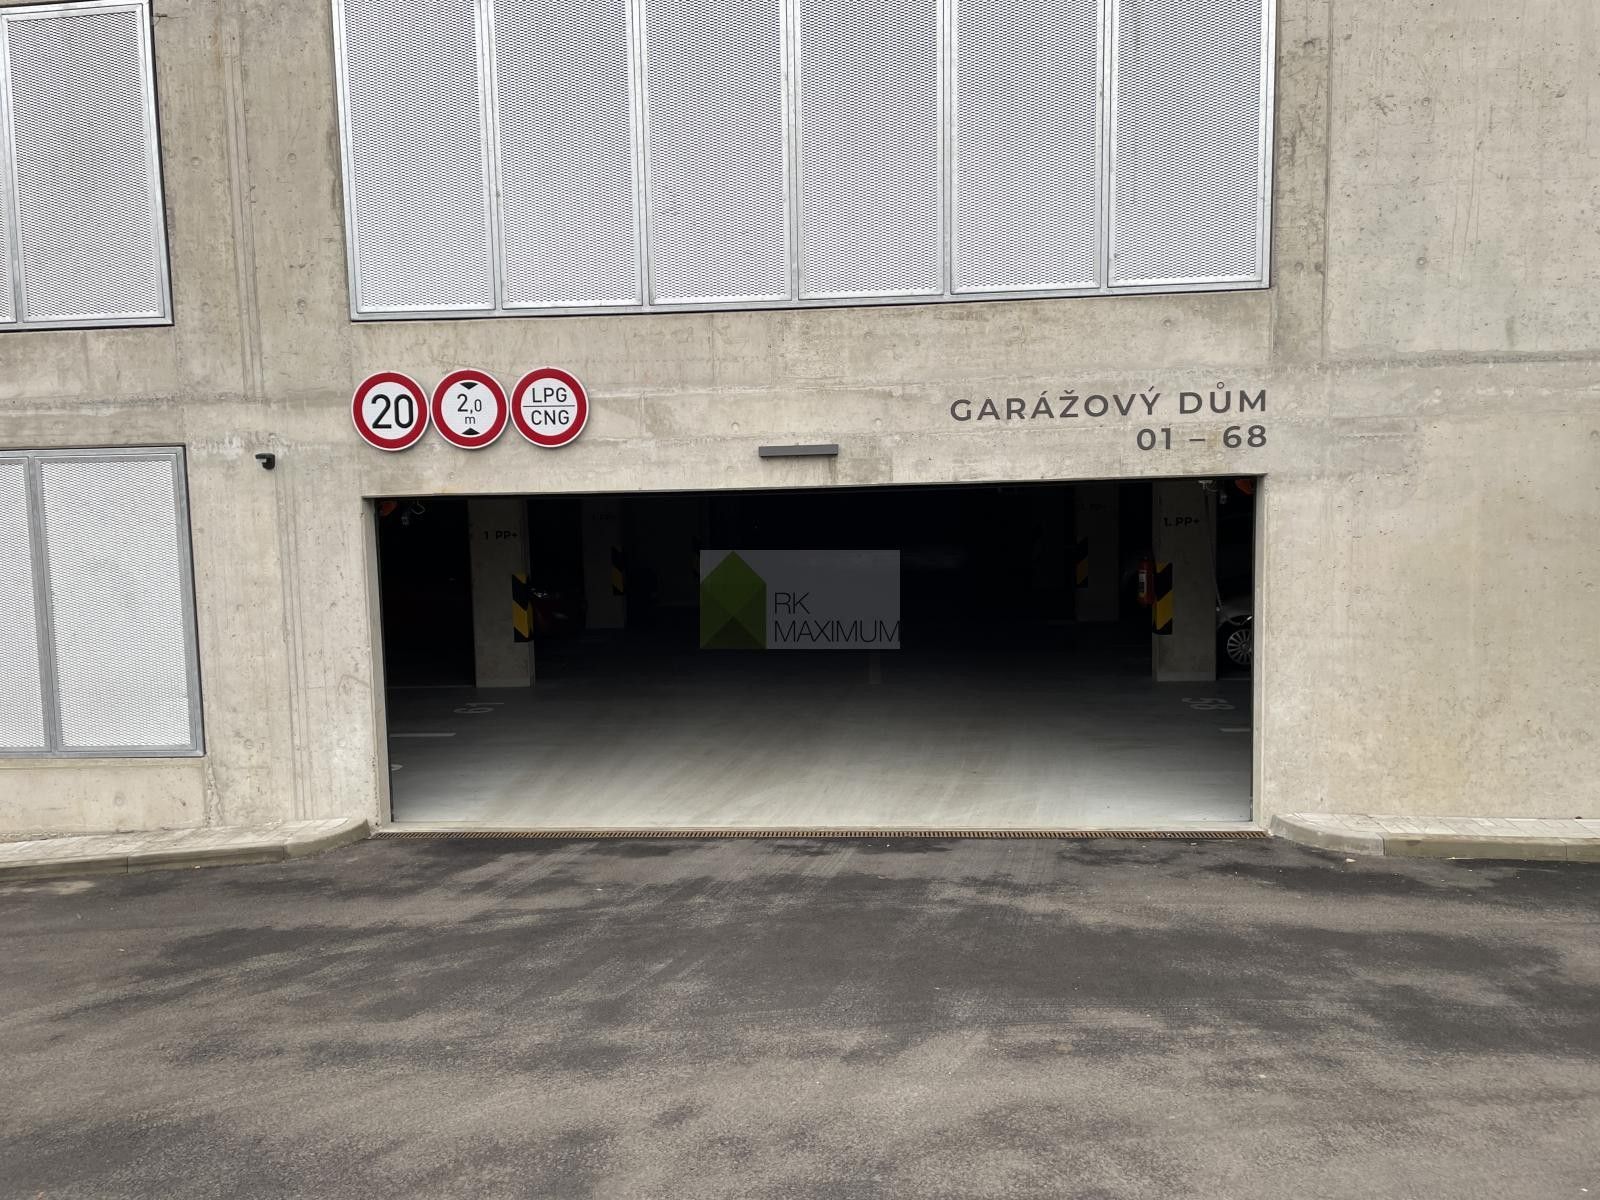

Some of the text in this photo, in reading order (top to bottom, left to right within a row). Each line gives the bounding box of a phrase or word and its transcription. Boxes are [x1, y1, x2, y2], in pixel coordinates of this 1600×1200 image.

[457, 394, 482, 413] 2,0
[532, 387, 567, 403] LPG
[950, 381, 1267, 421] GARÁŽOVÝ DŮM
[371, 394, 414, 429] 20
[465, 416, 476, 425] m
[531, 409, 570, 426] CNG
[1136, 427, 1172, 451] 01
[1223, 425, 1267, 449] 68
